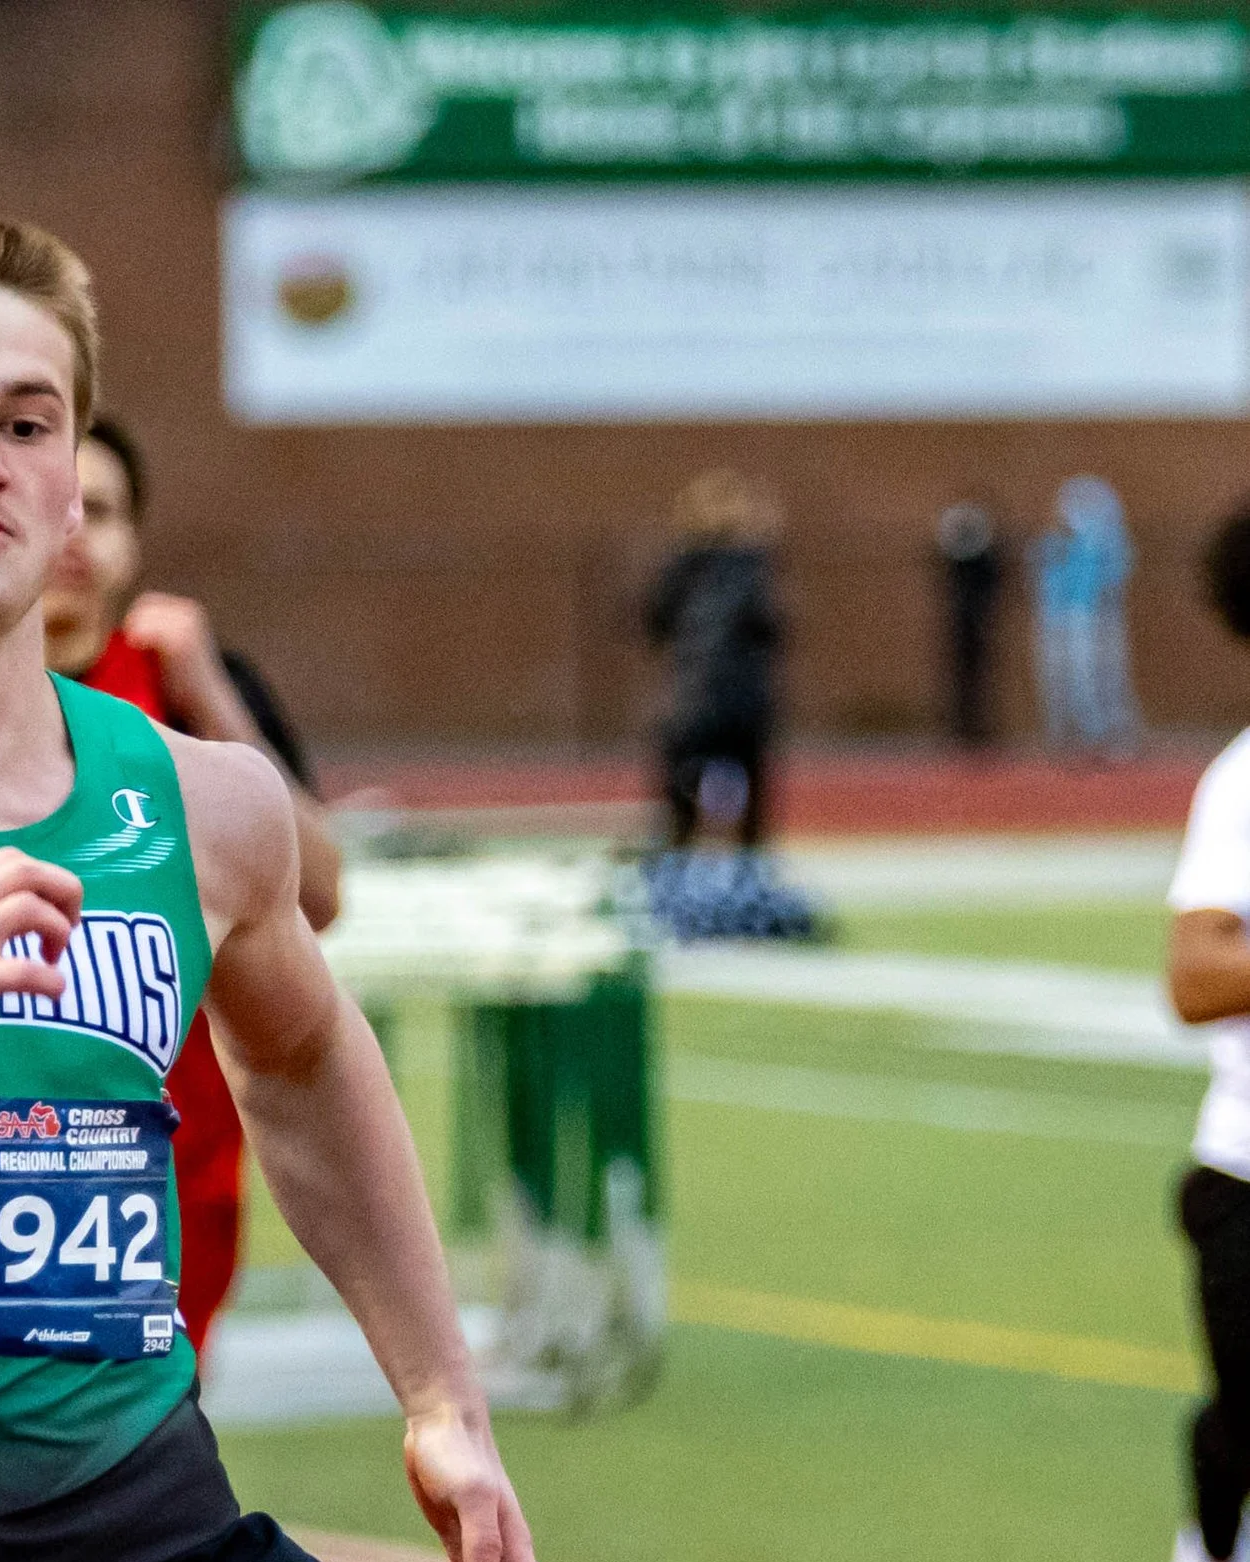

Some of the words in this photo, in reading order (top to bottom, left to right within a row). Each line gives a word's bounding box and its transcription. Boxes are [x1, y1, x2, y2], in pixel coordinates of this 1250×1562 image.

[67, 1108, 127, 1126] CROSS
[65, 1127, 141, 1146] COUNTRY
[0, 1151, 67, 1171] REGIONAL
[69, 1150, 148, 1171] CHAMPIONSHIP
[143, 1338, 172, 1353] 2942
